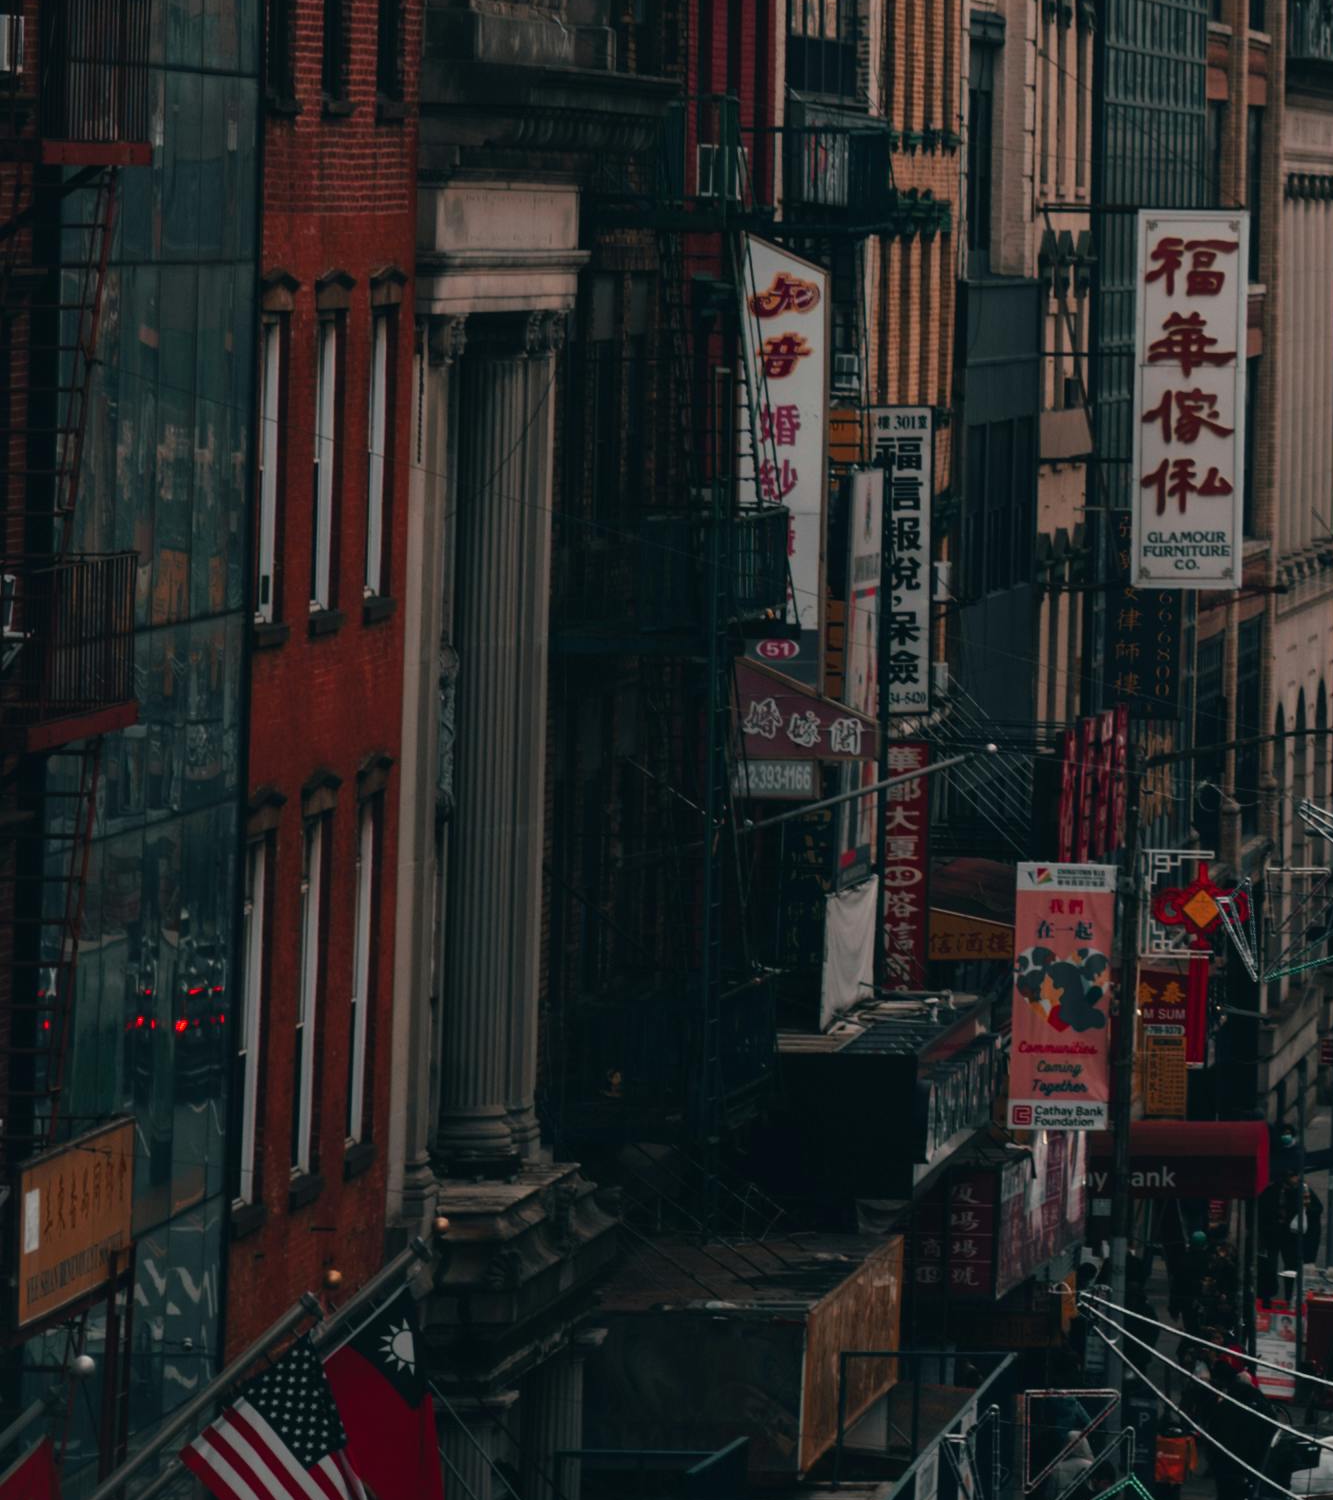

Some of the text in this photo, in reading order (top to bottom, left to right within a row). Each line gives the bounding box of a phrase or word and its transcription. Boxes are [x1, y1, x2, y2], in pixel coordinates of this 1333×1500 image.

[1142, 237, 1238, 516] 福華傢俬
[1146, 531, 1227, 544] GLAMOUR
[1143, 544, 1232, 558] FURNITURE
[1174, 558, 1201, 571] CO.
[765, 641, 791, 657] 51
[1050, 898, 1084, 915] 我們
[1037, 919, 1094, 940] 在一起
[1036, 1060, 1083, 1078] Coming
[1034, 1105, 1105, 1120] Cathay Bank
[1034, 1117, 1095, 1128] Foundation
